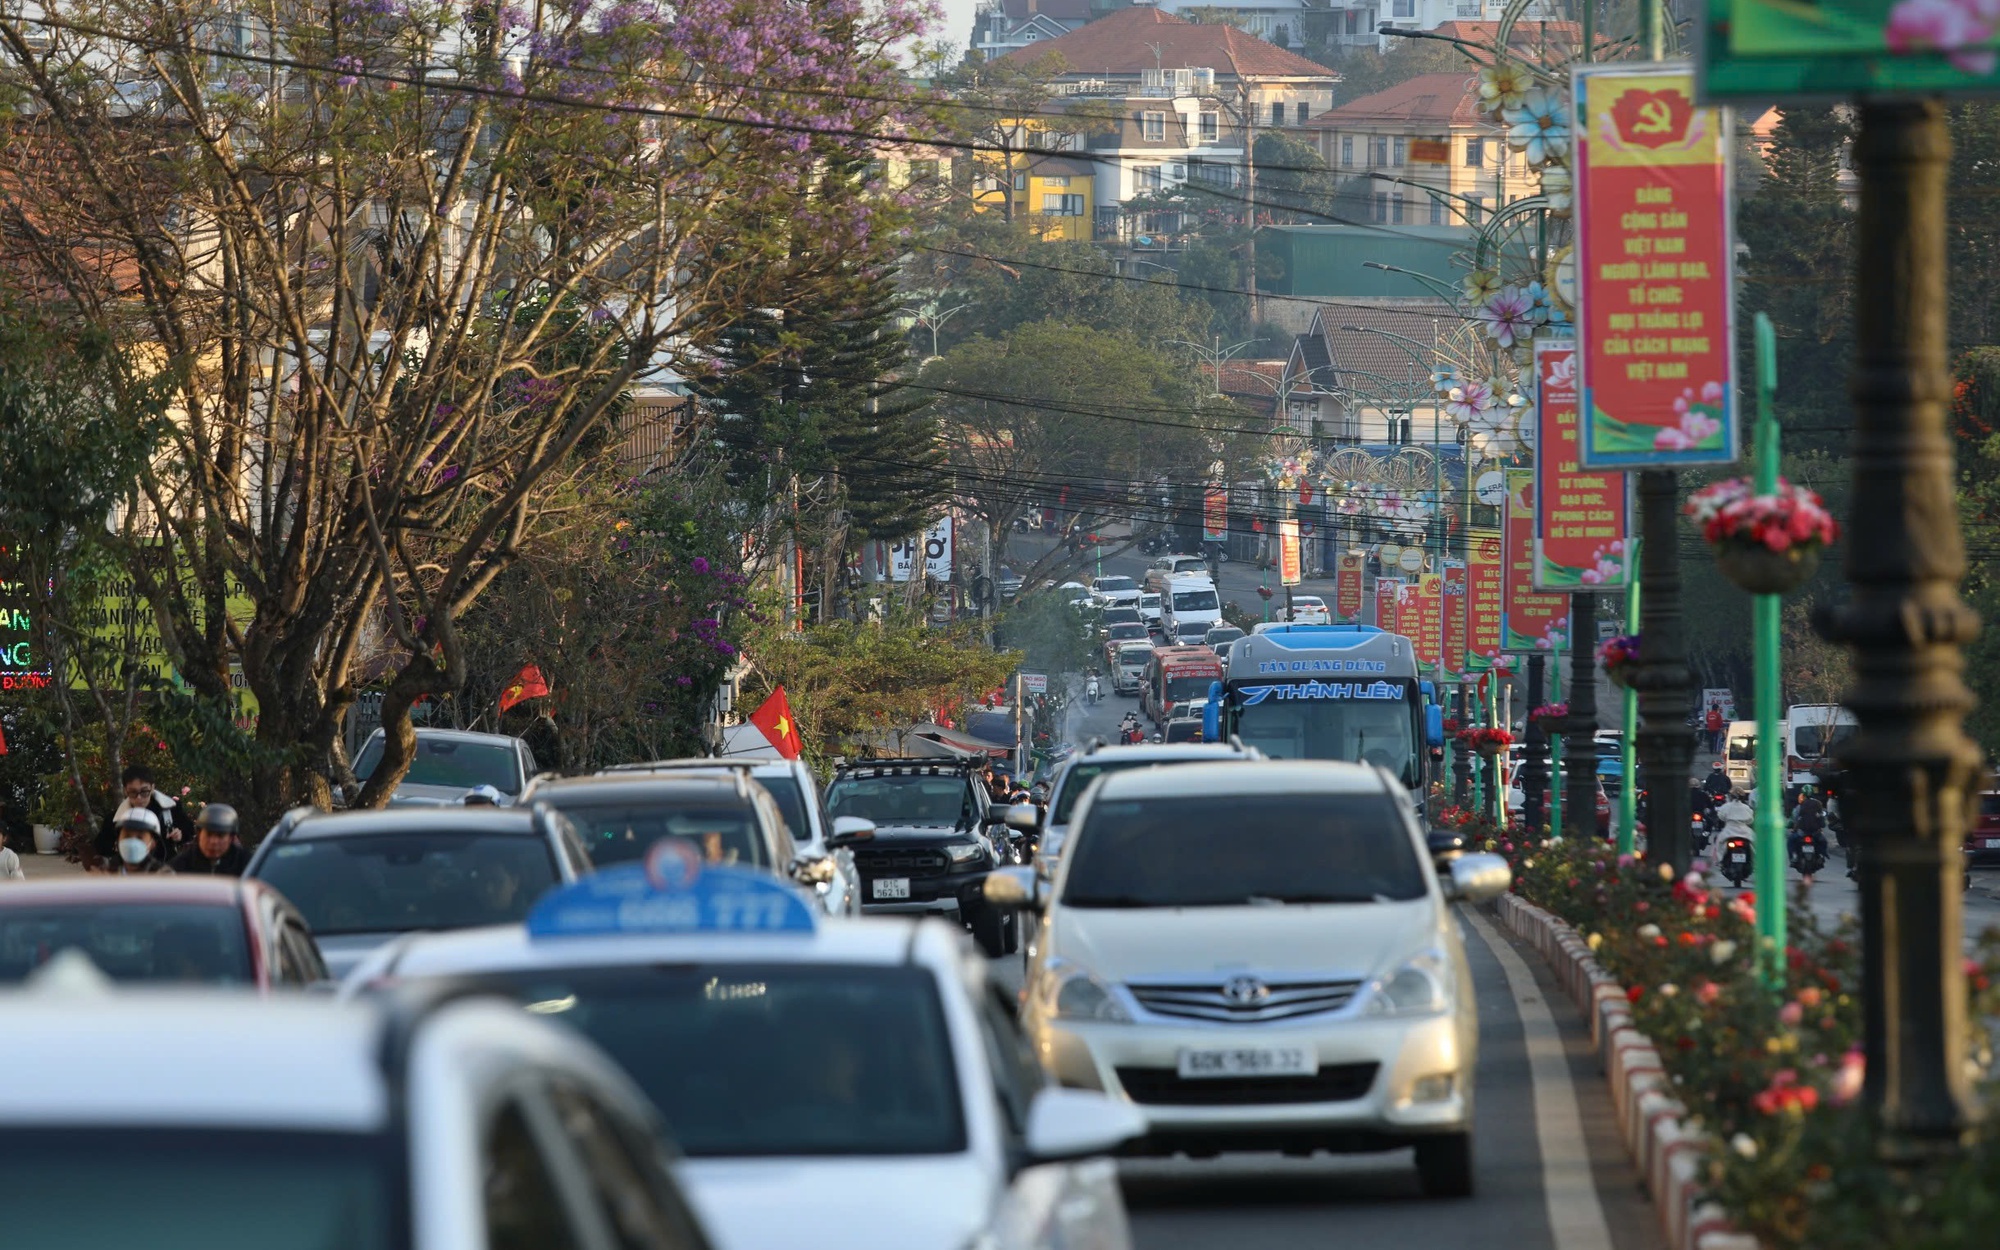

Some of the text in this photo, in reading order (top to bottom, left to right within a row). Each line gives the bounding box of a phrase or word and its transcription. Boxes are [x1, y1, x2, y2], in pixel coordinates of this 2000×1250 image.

[1621, 207, 1688, 232] CỘNG SẢN
[1624, 236, 1685, 257] VIỆT NAM
[1600, 260, 1640, 280] NGƯỜI
[1643, 260, 1678, 279] LÃNH
[1629, 283, 1683, 305] TỔ CHỨC
[1609, 308, 1703, 332] MỌI THẮNG LỢI
[1603, 334, 1710, 357] CỦA CÁCH MẠNG
[1626, 361, 1688, 382] VIỆT NAM
[1259, 657, 1386, 674] TÂN QUANG DŨNG
[1273, 679, 1404, 700] THÀNH LIÊN
